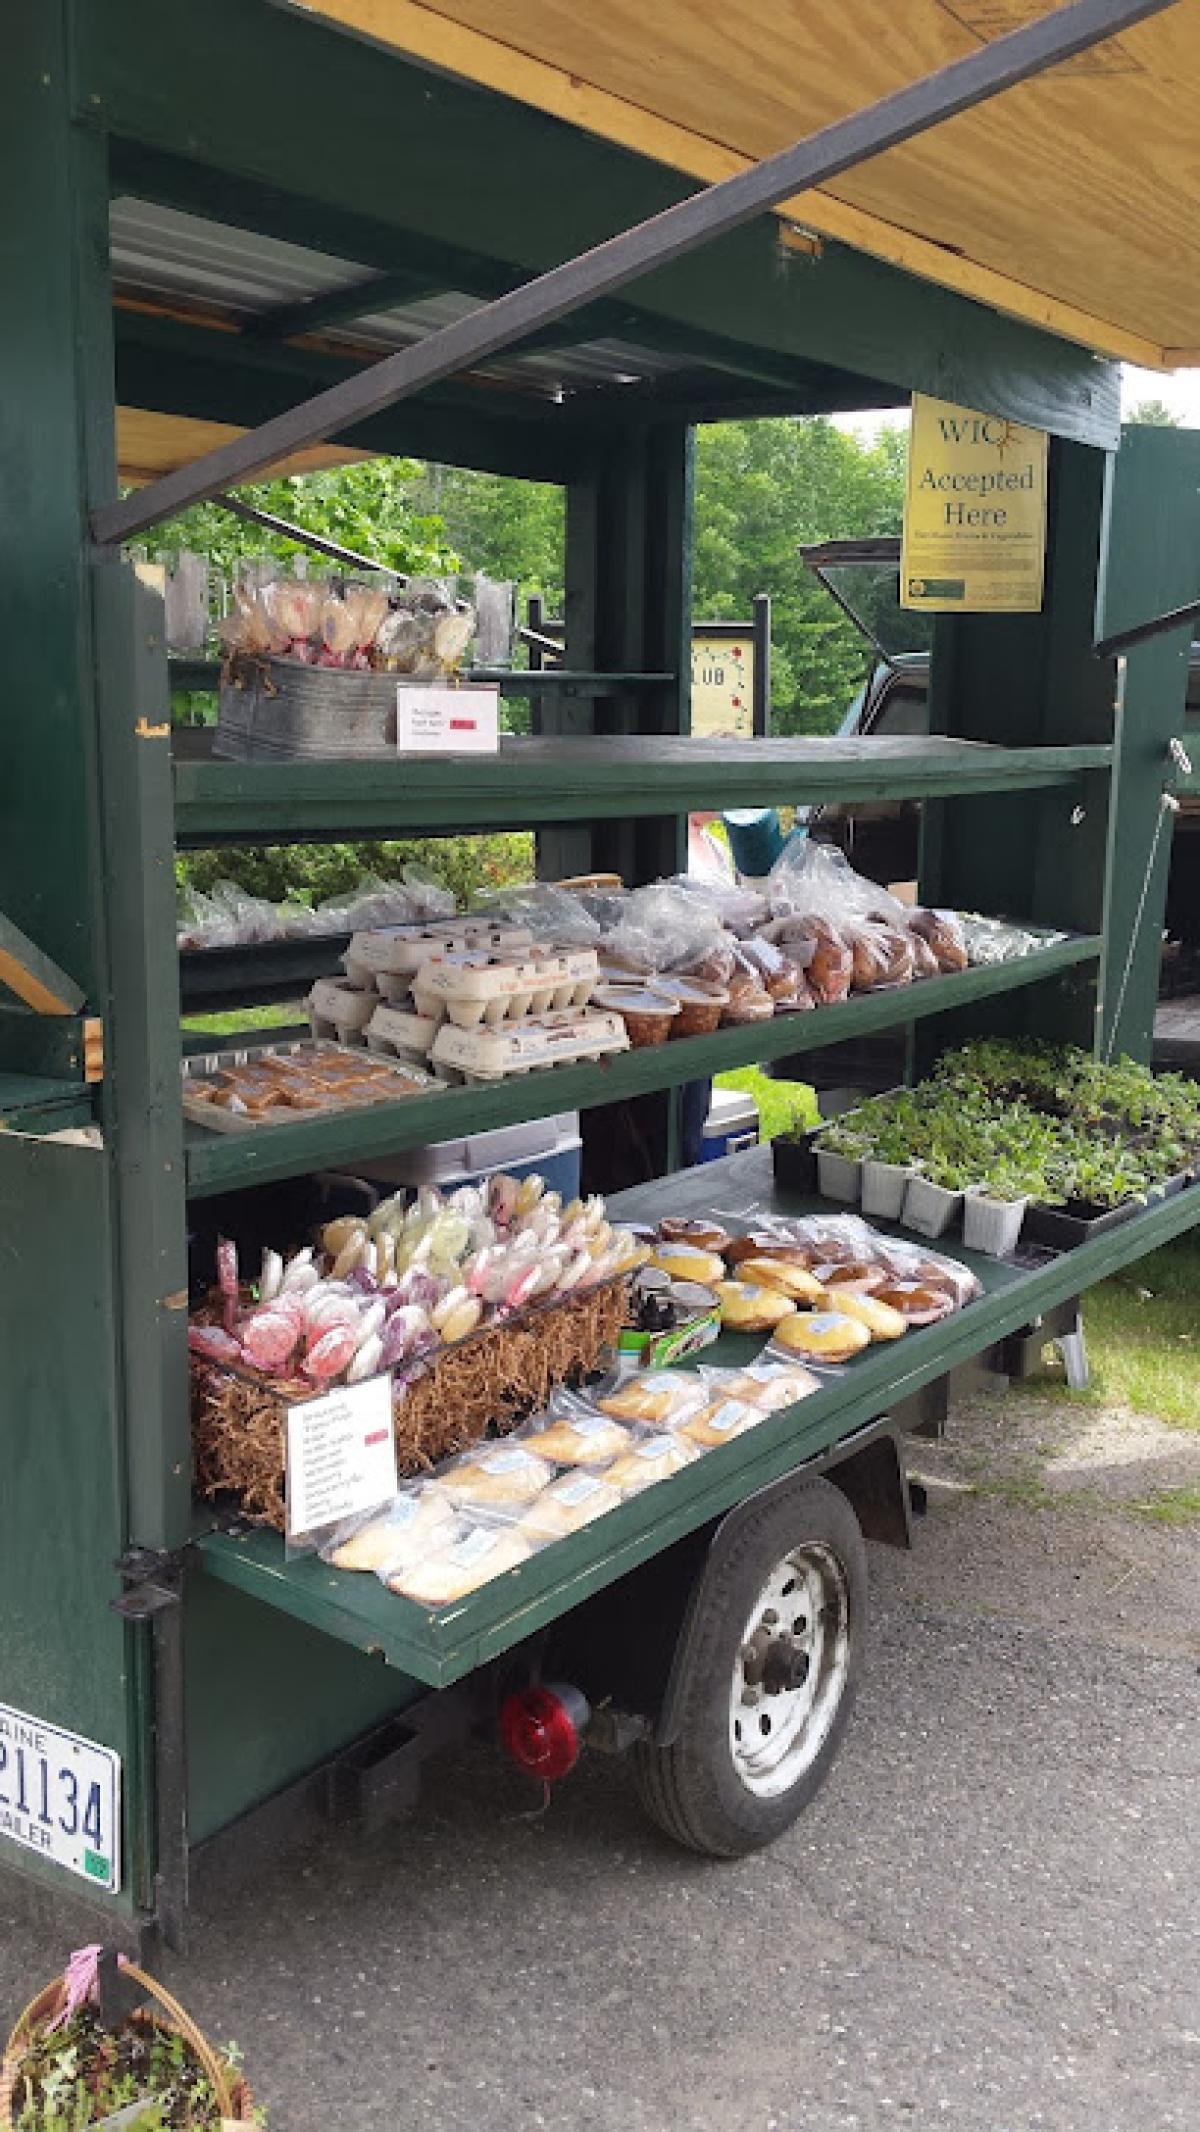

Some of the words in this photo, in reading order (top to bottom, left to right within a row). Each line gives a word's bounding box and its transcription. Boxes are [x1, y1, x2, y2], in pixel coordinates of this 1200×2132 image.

[938, 417, 1001, 445] WIC
[917, 464, 1034, 498] Accepted
[943, 502, 1007, 526] Here
